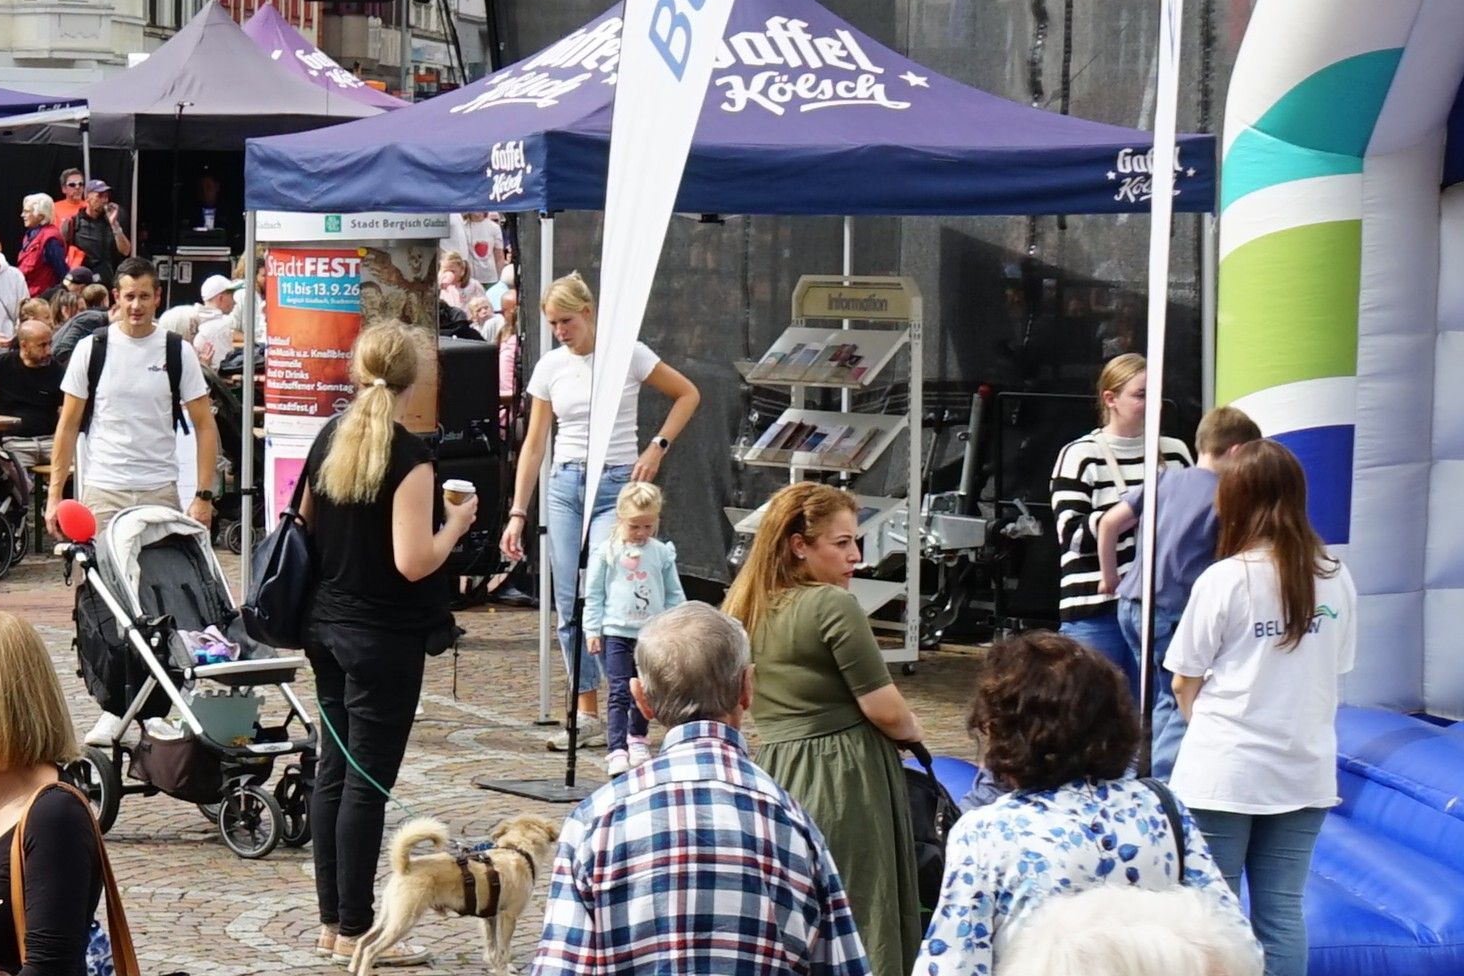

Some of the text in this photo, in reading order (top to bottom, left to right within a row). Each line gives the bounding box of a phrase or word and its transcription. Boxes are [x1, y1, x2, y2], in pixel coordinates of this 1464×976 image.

[711, 16, 884, 74] affel
[716, 71, 911, 116] Kölsch
[491, 140, 526, 171] Gaffel
[350, 218, 380, 229] Stadt
[383, 218, 422, 231] Bergisch
[267, 256, 361, 278] StadtFEST
[828, 293, 888, 311] Information
[317, 382, 354, 394] Sonntag
[1254, 618, 1322, 638] BELW
